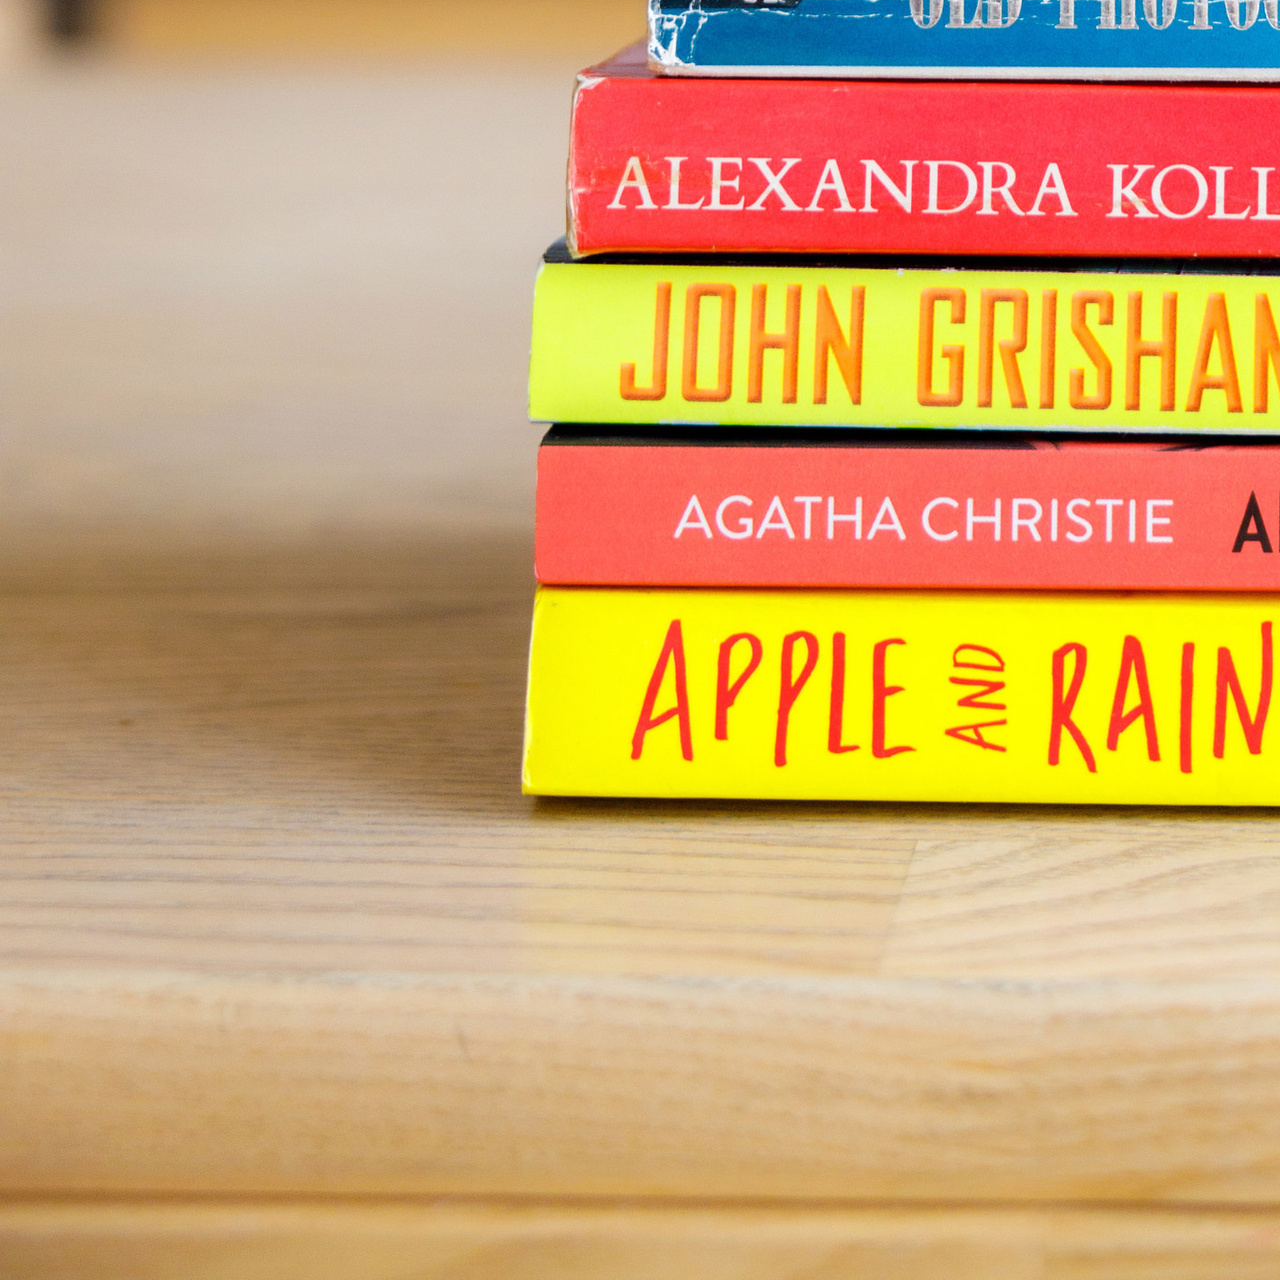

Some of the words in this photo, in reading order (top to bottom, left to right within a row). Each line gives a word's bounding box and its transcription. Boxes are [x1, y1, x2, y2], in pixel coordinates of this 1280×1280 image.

[607, 156, 1078, 218] ALEXANDRA
[619, 281, 866, 406] JOHN
[673, 495, 906, 542] AGATHA
[922, 497, 1174, 544] CHRISTIE
[631, 618, 917, 768] APPLE
[944, 642, 1008, 753] AND
[1047, 620, 1275, 773] RAIN
